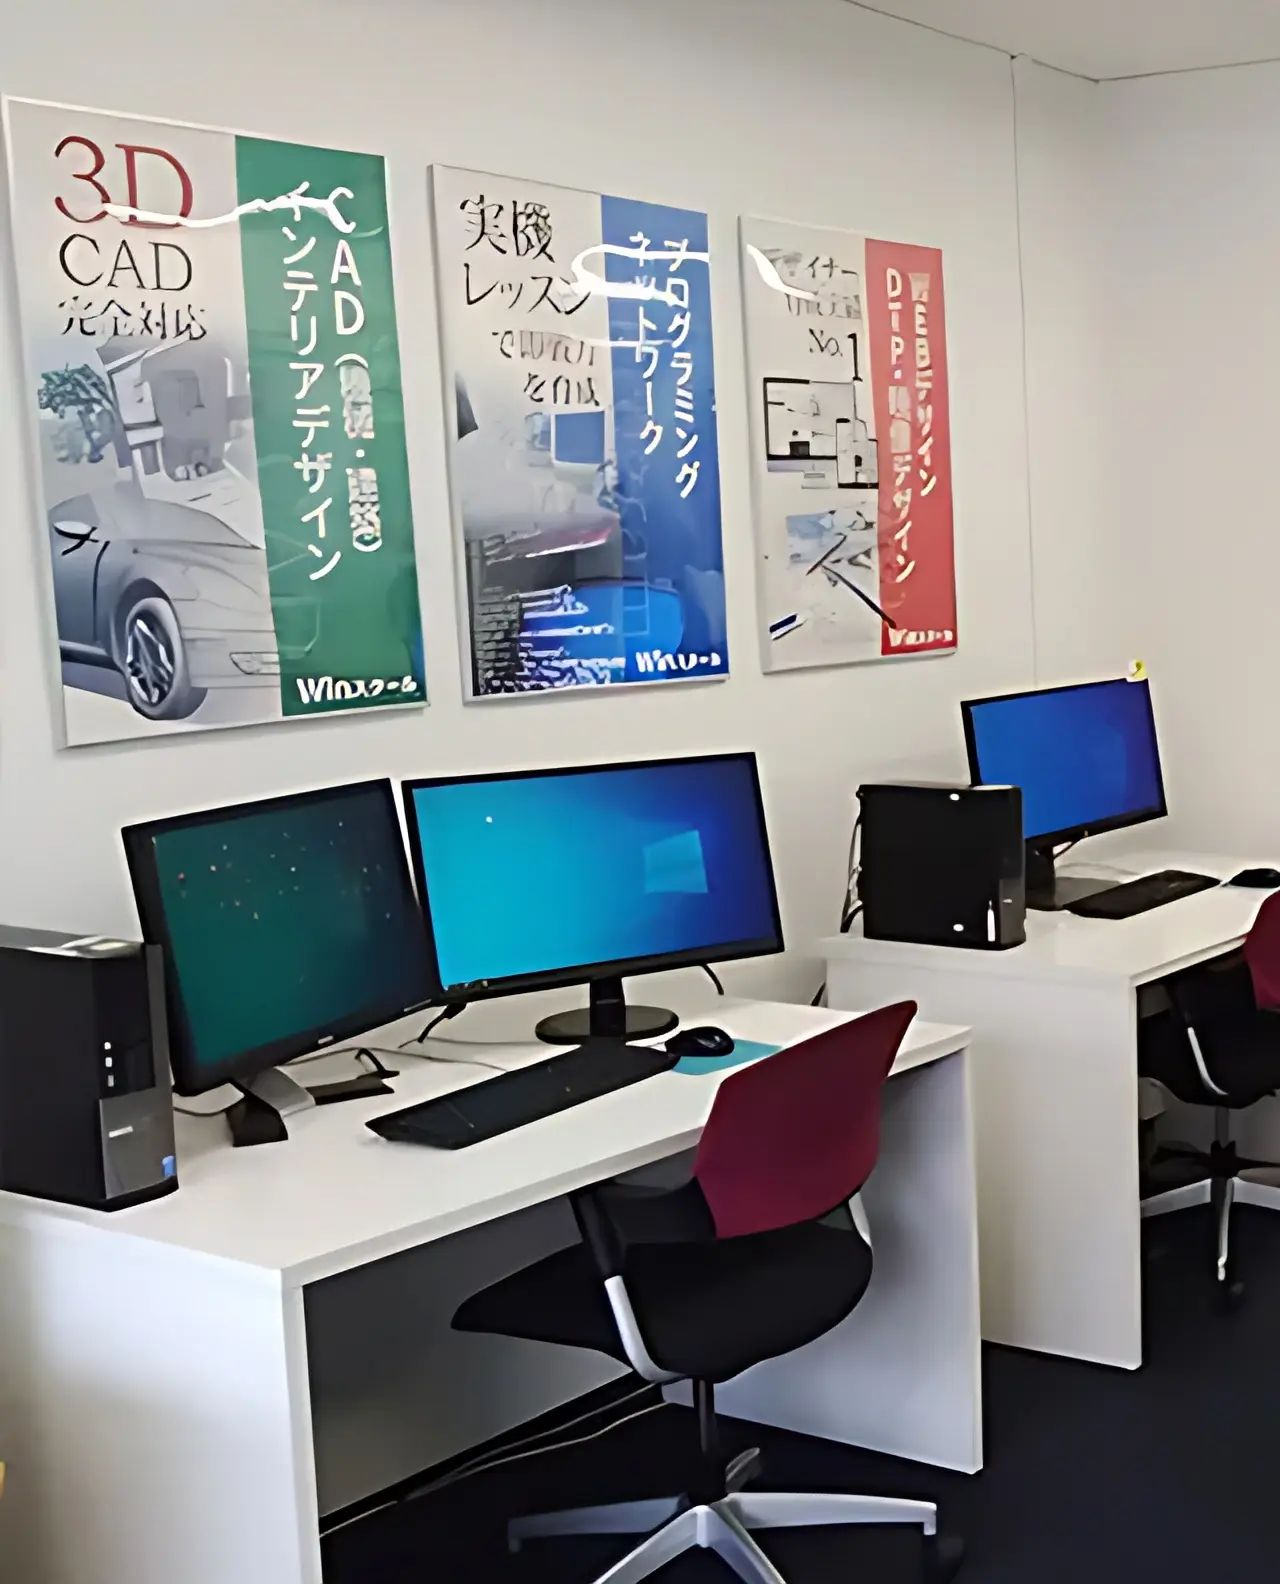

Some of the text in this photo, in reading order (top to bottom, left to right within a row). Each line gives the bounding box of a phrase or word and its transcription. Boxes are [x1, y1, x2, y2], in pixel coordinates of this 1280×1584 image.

[55, 135, 194, 228] 3D
[59, 234, 193, 292] CAD
[463, 262, 592, 316] レッスン
[326, 186, 384, 552] CAD（・）
[886, 267, 916, 583] DTP・デザイン
